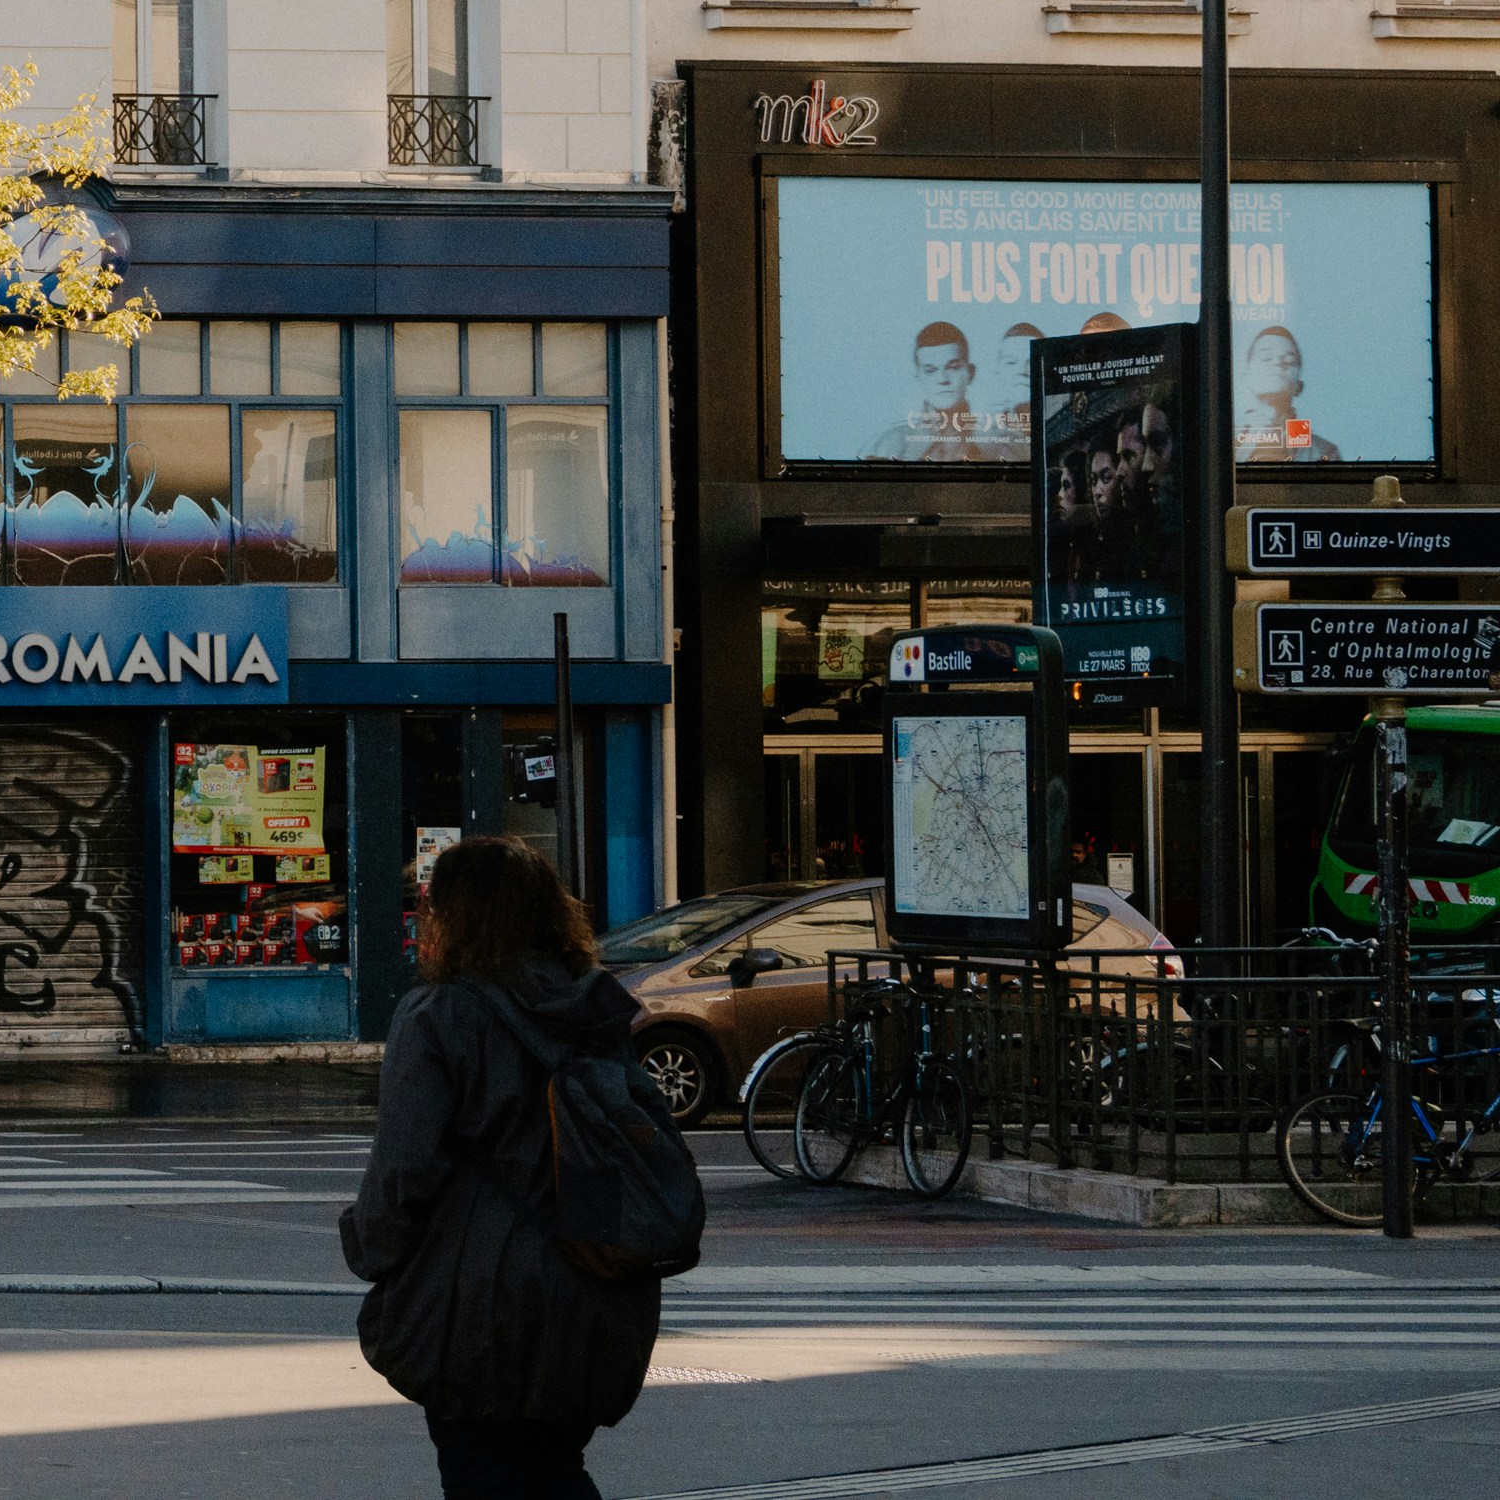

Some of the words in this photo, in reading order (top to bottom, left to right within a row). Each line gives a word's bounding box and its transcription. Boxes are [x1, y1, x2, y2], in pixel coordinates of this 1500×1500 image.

[753, 78, 880, 147] mk2
[958, 190, 1005, 208] FEEL
[1011, 191, 1069, 209] GOOD
[1074, 192, 1136, 209] MOVIE
[1140, 192, 1201, 210] COMM
[1230, 193, 1283, 210] EULS
[925, 208, 968, 230] LES
[973, 209, 1074, 231] ANGLAIS
[1079, 210, 1169, 233] SAVENT
[1174, 212, 1202, 233] LE
[1230, 213, 1273, 233] AIRE
[926, 240, 1021, 304] PLUS
[1029, 242, 1123, 305] FORT
[1130, 243, 1202, 319] QUE
[1069, 362, 1101, 373] THRILLER
[1102, 358, 1134, 369] JOUISSIF
[1135, 354, 1164, 366] MÊLANT
[1062, 372, 1095, 383] POUVOIR,
[1096, 370, 1114, 380] LUXE
[1115, 369, 1124, 377] ET
[1125, 366, 1150, 377] SURVIE
[1007, 413, 1030, 424] BAFT
[1237, 431, 1280, 445] CINÉMA
[1328, 531, 1451, 552] Quinze-Vingts
[1060, 597, 1166, 620] PRIVILÈGES
[1310, 616, 1375, 635] Centre
[1385, 617, 1468, 635] National
[928, 650, 972, 672] Bastille
[1131, 646, 1151, 662] HBO
[1328, 642, 1492, 663] d'Ophtalmologie
[1079, 660, 1090, 673] LE
[1090, 660, 1101, 672] 27
[1101, 659, 1126, 671] MARS
[1131, 661, 1150, 673] max
[1311, 664, 1336, 680] 28,
[1344, 665, 1374, 679] Rue
[1092, 694, 1124, 703] JCDecaux
[267, 818, 301, 827] OFFERT
[1469, 894, 1496, 906] 50008
